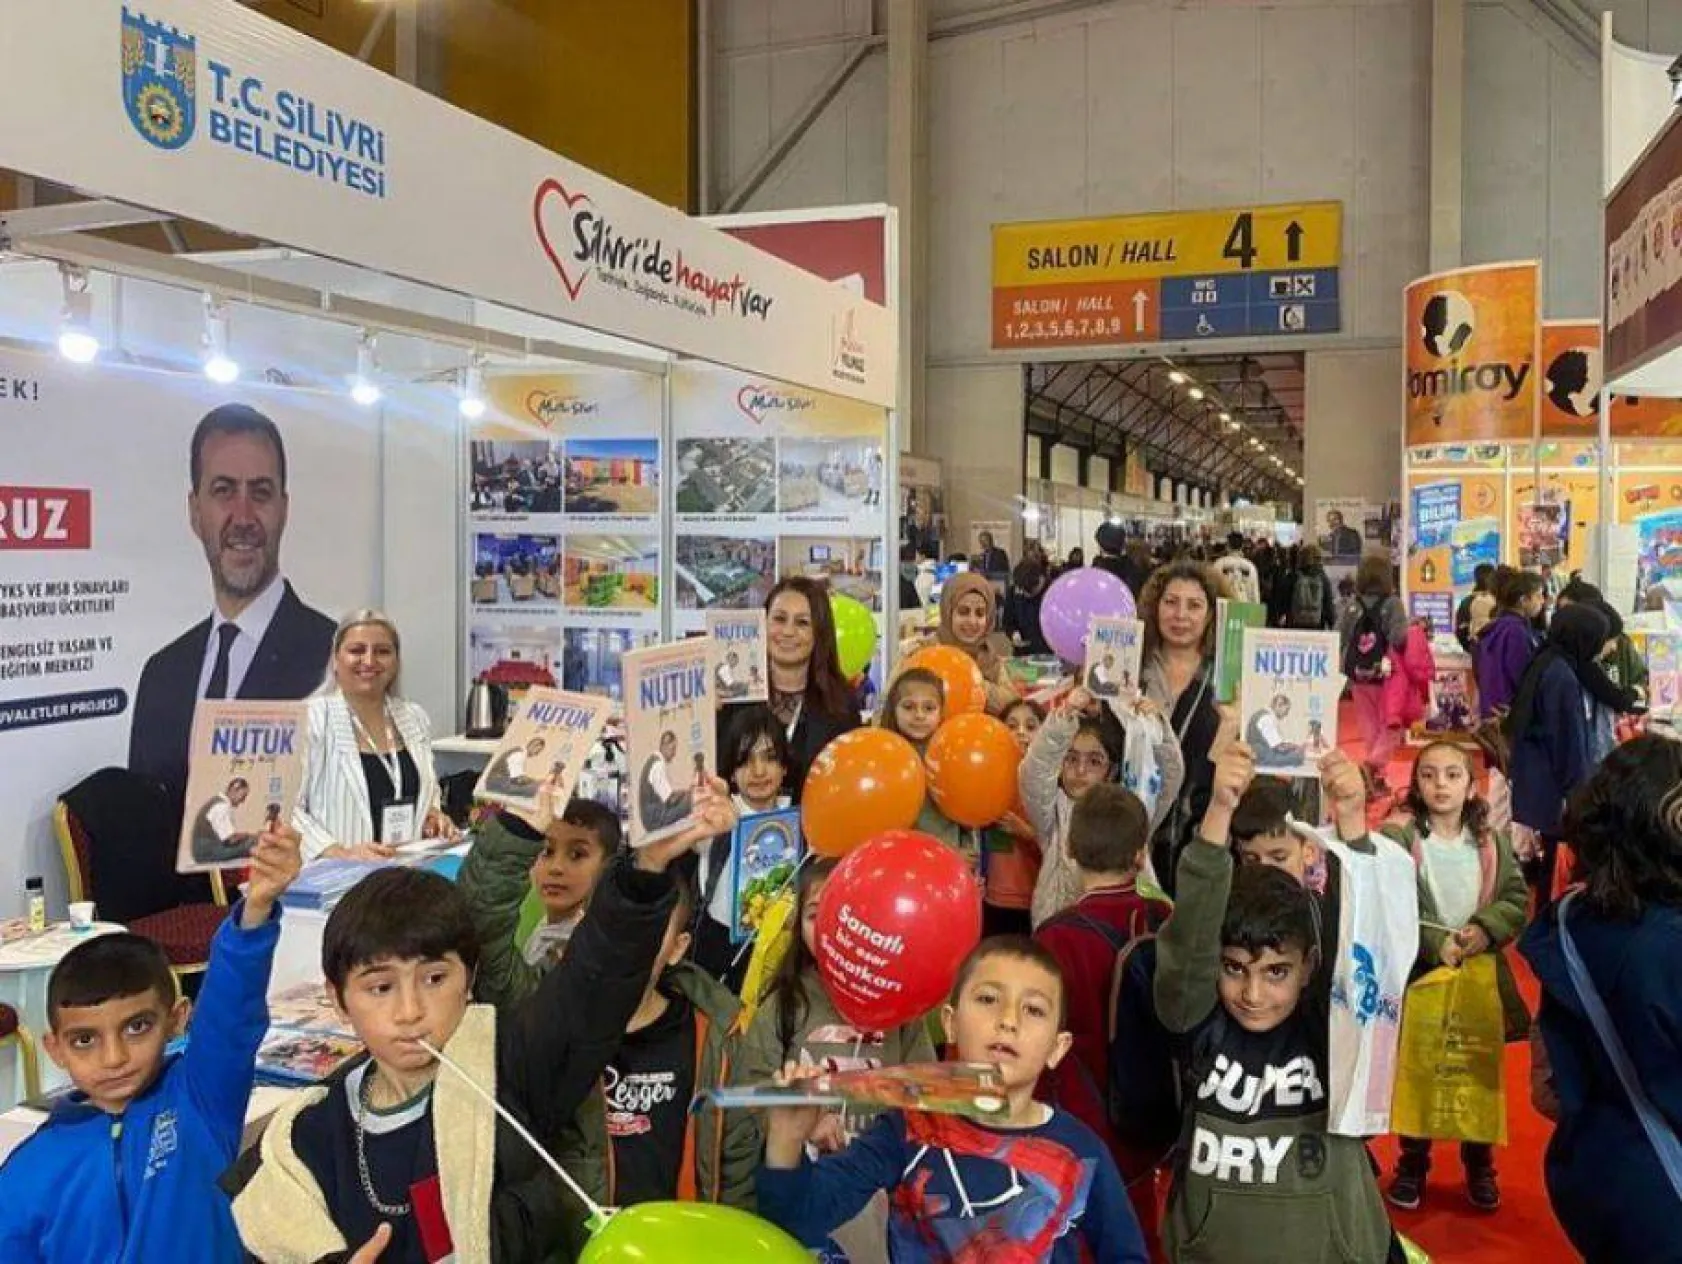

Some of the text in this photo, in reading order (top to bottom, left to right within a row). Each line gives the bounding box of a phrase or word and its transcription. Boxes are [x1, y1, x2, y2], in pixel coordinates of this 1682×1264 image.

[208, 60, 270, 121] T.C.
[1027, 243, 1099, 270] SALON
[1120, 238, 1177, 264] HALL
[1223, 211, 1258, 268] 4
[676, 250, 744, 317] hayat
[740, 287, 773, 321] var
[1076, 294, 1114, 312] HALL
[26, 582, 42, 597] VE
[98, 635, 113, 653] VE
[714, 623, 760, 641] NUTUK
[1096, 628, 1136, 648] NUTUK
[1255, 650, 1329, 678] NUTUK
[640, 665, 706, 710] NUTUK
[527, 701, 596, 731] NUTUK
[211, 726, 295, 756] NUTUK
[1189, 1126, 1295, 1184] DRY
